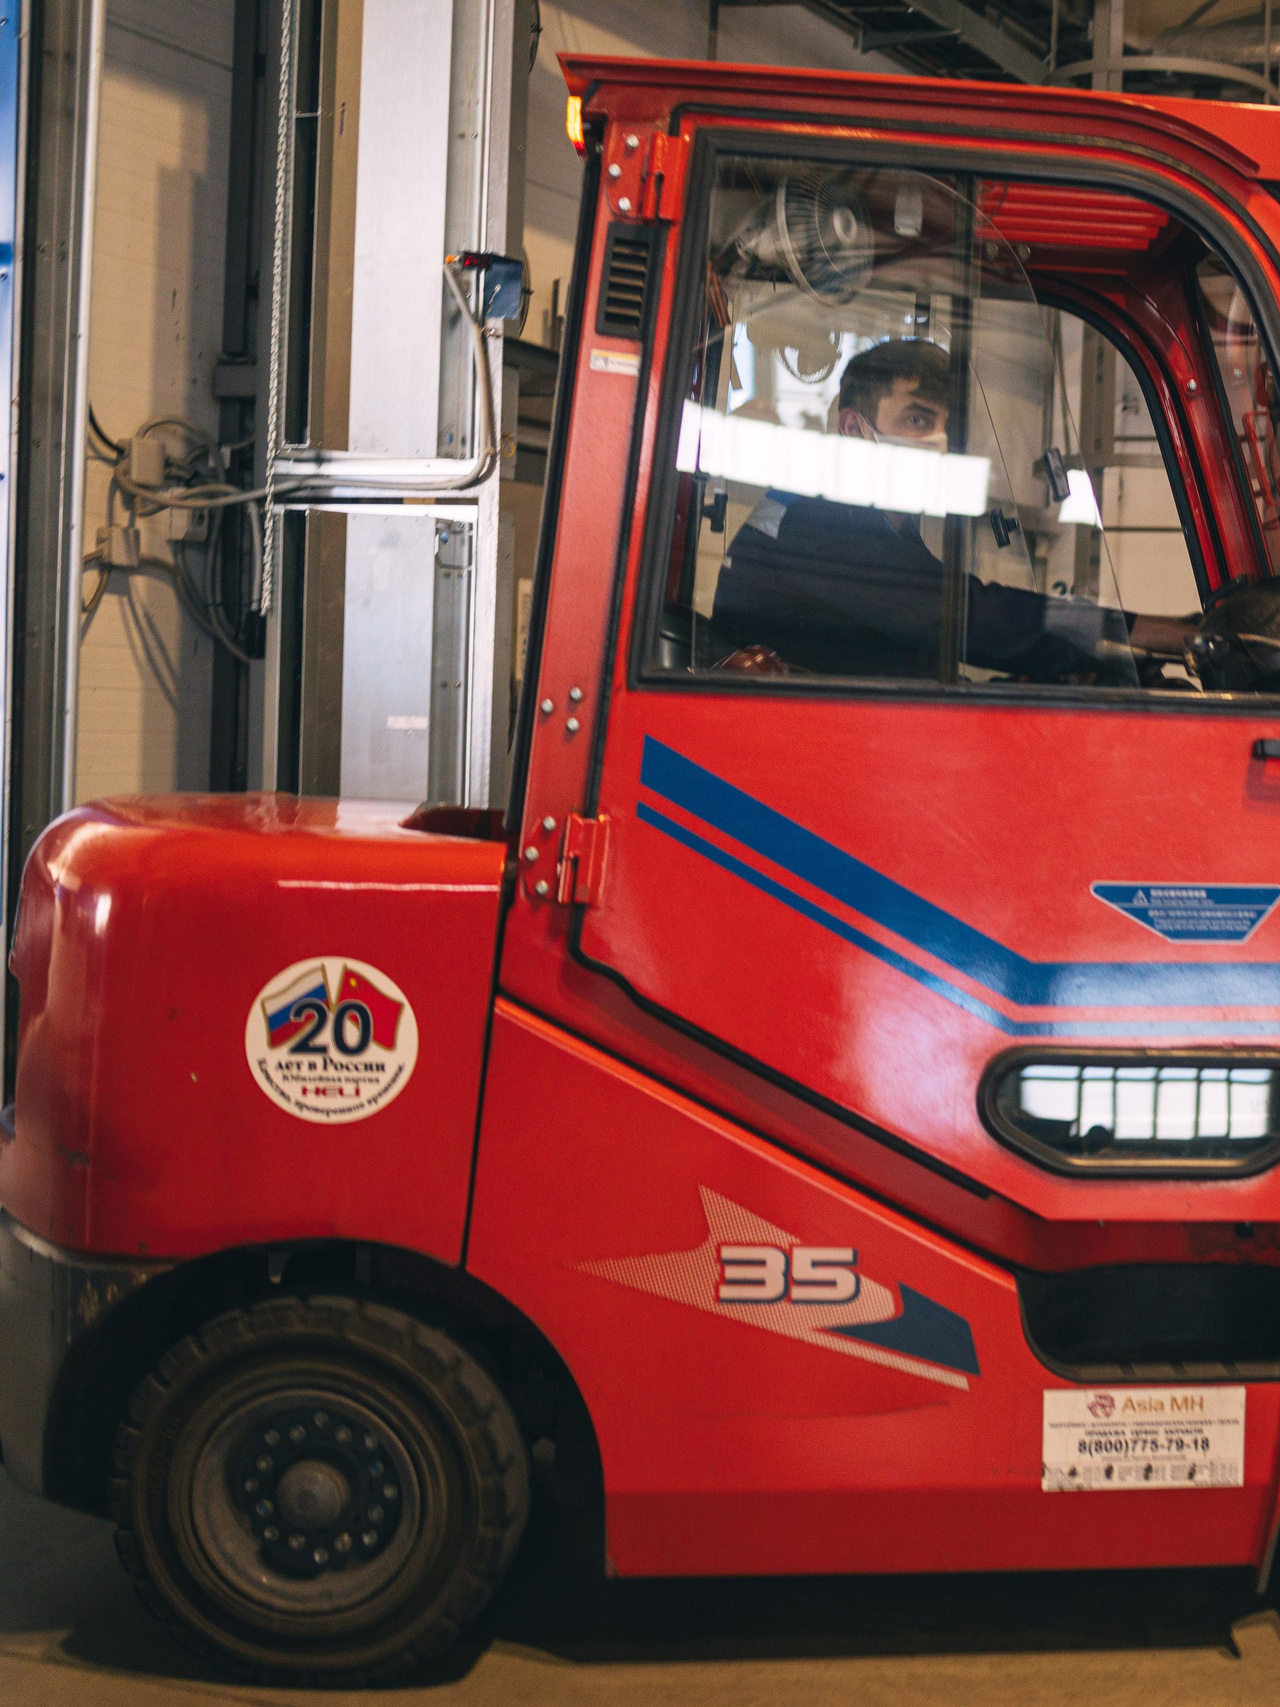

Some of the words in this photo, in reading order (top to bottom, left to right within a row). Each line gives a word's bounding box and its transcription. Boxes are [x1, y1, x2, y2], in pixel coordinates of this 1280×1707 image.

[288, 998, 374, 1056] 20
[322, 1056, 386, 1073] России
[718, 1245, 860, 1305] 35
[1121, 1395, 1165, 1414] Asia
[1170, 1394, 1205, 1413] MH
[1078, 1437, 1211, 1457] 8(800)775-79-18
